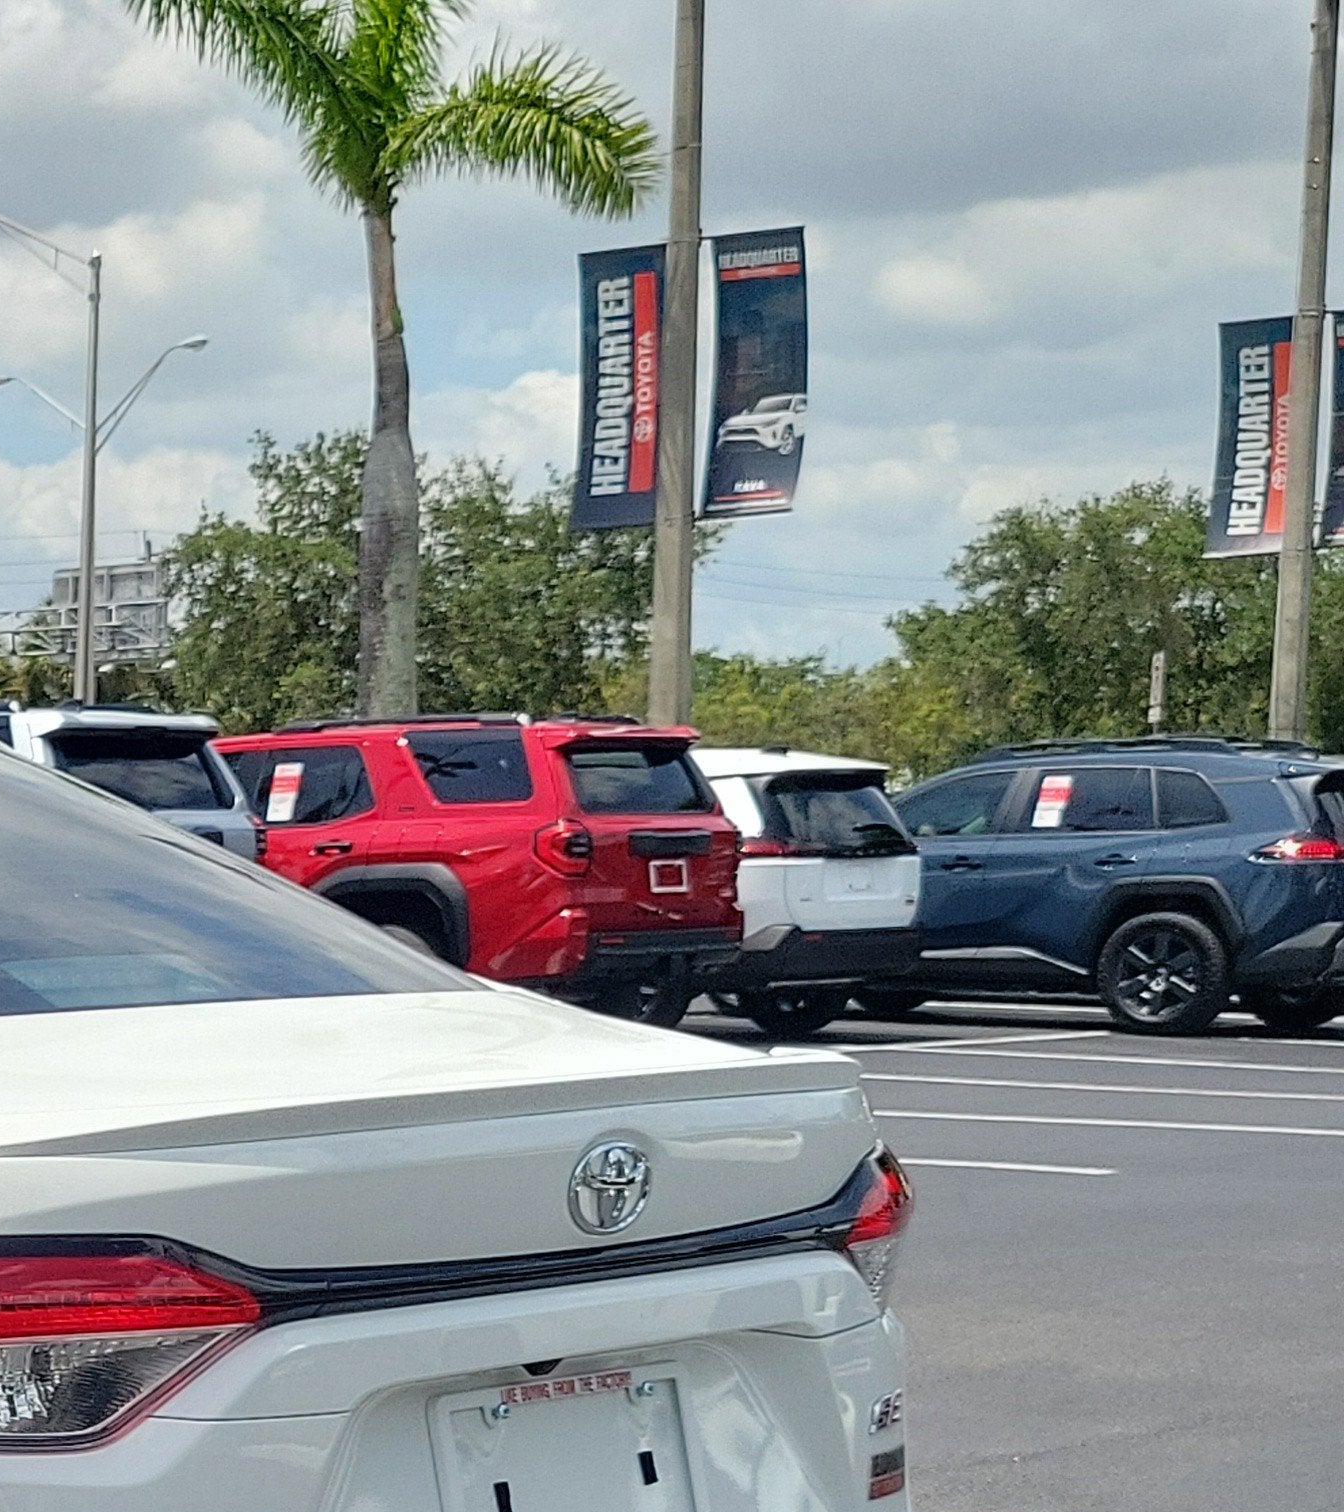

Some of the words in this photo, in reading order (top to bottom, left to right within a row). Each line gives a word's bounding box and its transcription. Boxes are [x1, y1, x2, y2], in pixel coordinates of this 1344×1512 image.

[591, 277, 634, 495] HEADQUARTER
[636, 331, 655, 415] TOYOTA
[1227, 345, 1271, 535] HEADQUARTER
